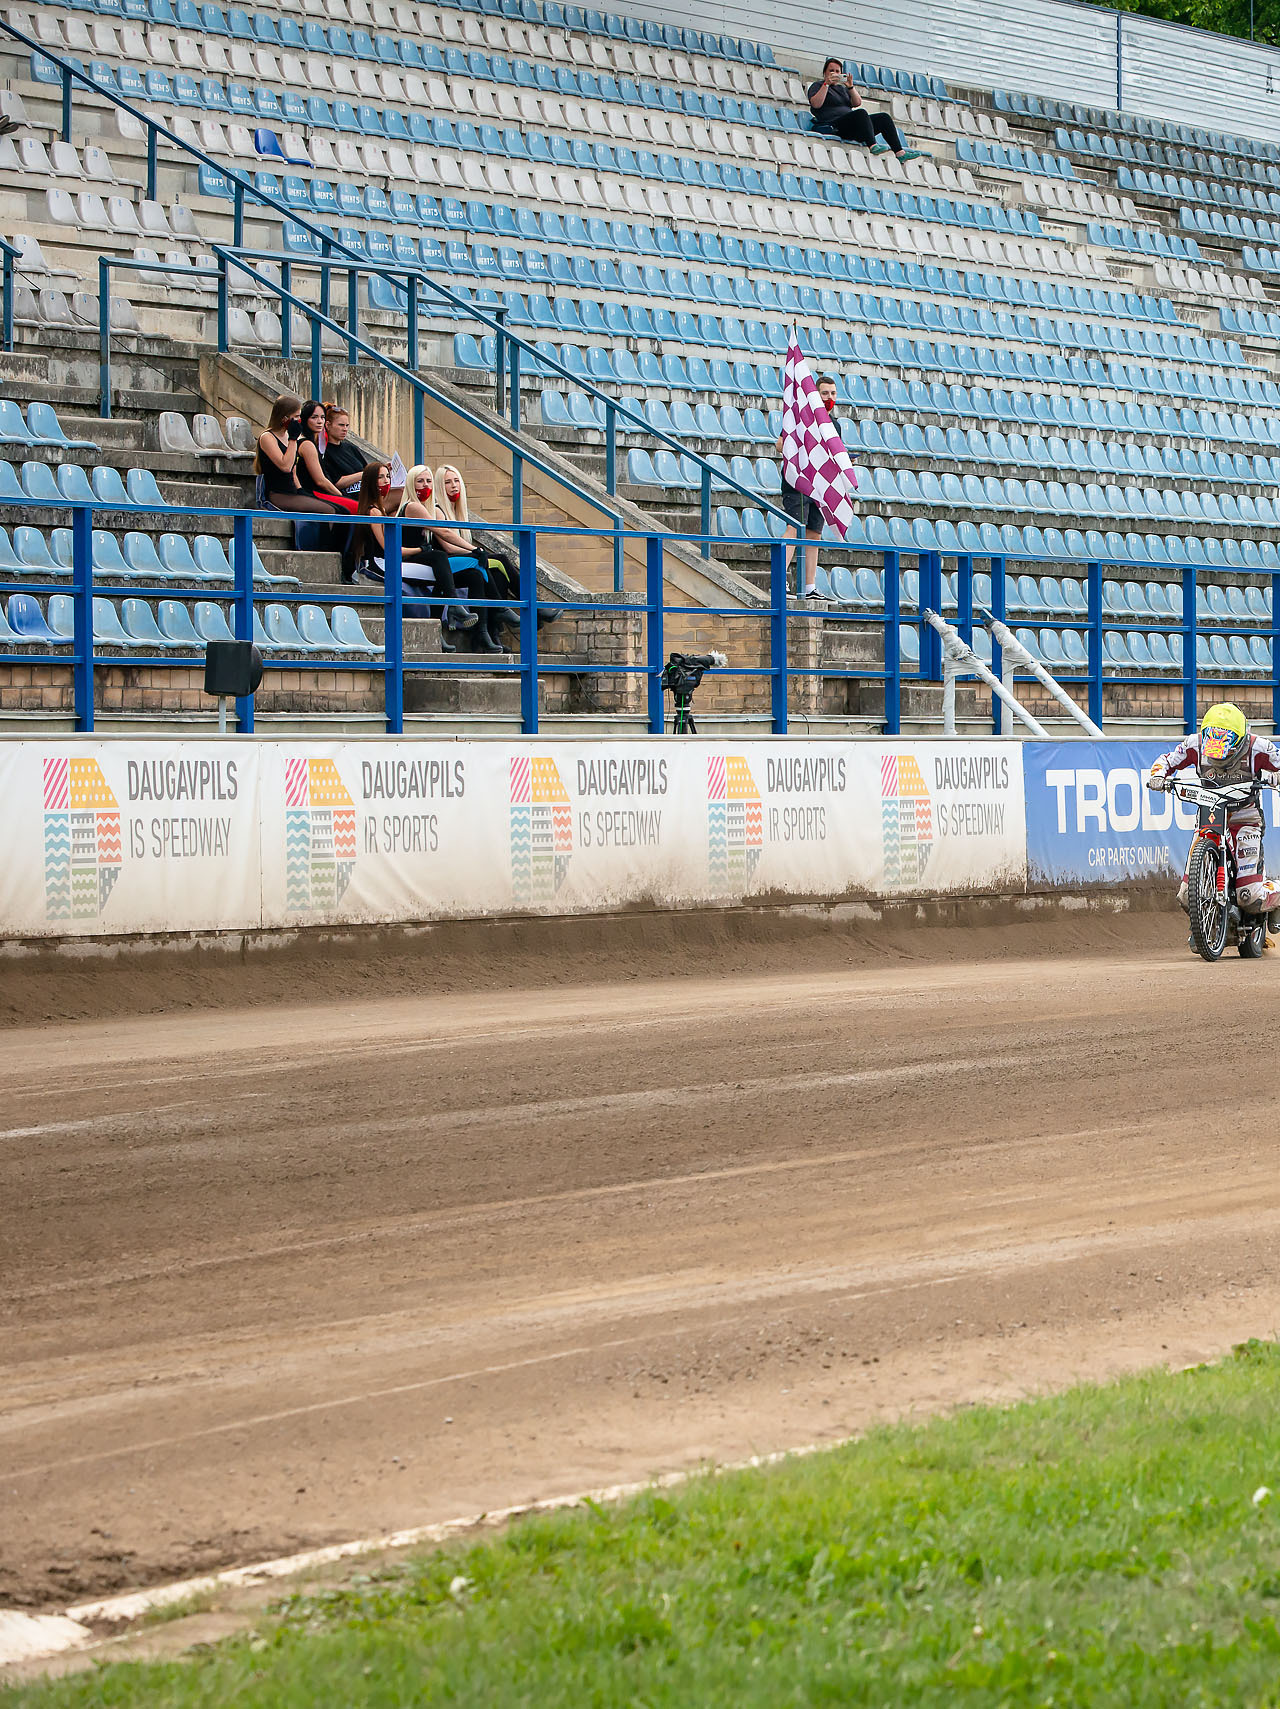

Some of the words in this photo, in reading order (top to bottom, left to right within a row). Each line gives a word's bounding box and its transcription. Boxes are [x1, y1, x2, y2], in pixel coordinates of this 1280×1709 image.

[128, 760, 238, 800] DAUGAVPILS
[362, 760, 465, 798] DAUGAVPILS
[577, 759, 668, 796] DAUGAVPILS
[767, 757, 846, 792] DAUGAVPILS
[935, 756, 1009, 790] DAUGAVPILS
[130, 818, 144, 858] IS
[151, 818, 231, 858] SPEEDWAY
[364, 816, 378, 854] IR
[383, 814, 439, 853] SPORTS
[578, 810, 591, 848] IS
[596, 809, 662, 846] SPEEDWAY
[769, 808, 779, 841] IR
[784, 807, 827, 841] SPORTS
[937, 804, 948, 837] IS
[952, 803, 1006, 836] SPEEDWAY
[1089, 848, 1106, 866] CAR
[1108, 847, 1136, 866] PARTS
[1138, 846, 1169, 864] ONLINE
